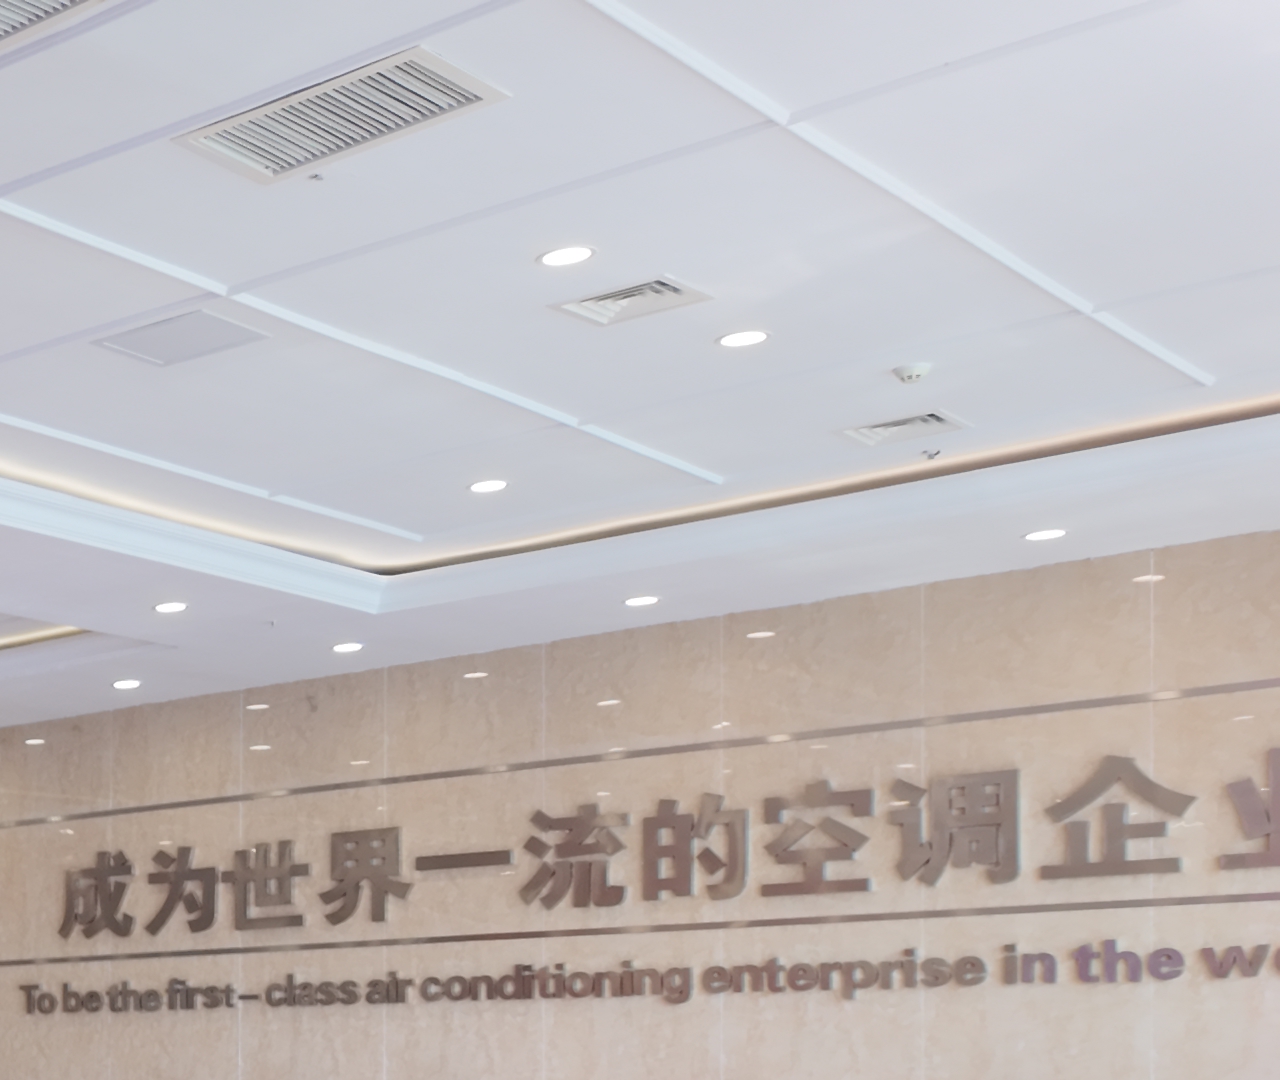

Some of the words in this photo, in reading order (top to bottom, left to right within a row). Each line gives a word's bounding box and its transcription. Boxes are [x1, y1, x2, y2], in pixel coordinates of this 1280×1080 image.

[20, 984, 58, 1014] To
[62, 982, 101, 1012] be
[106, 980, 163, 1012] the
[365, 971, 413, 1004] air
[420, 960, 694, 1004] conditioning
[701, 948, 987, 1000] enterprise
[1002, 943, 1057, 985] in
[1071, 939, 1185, 983] the
